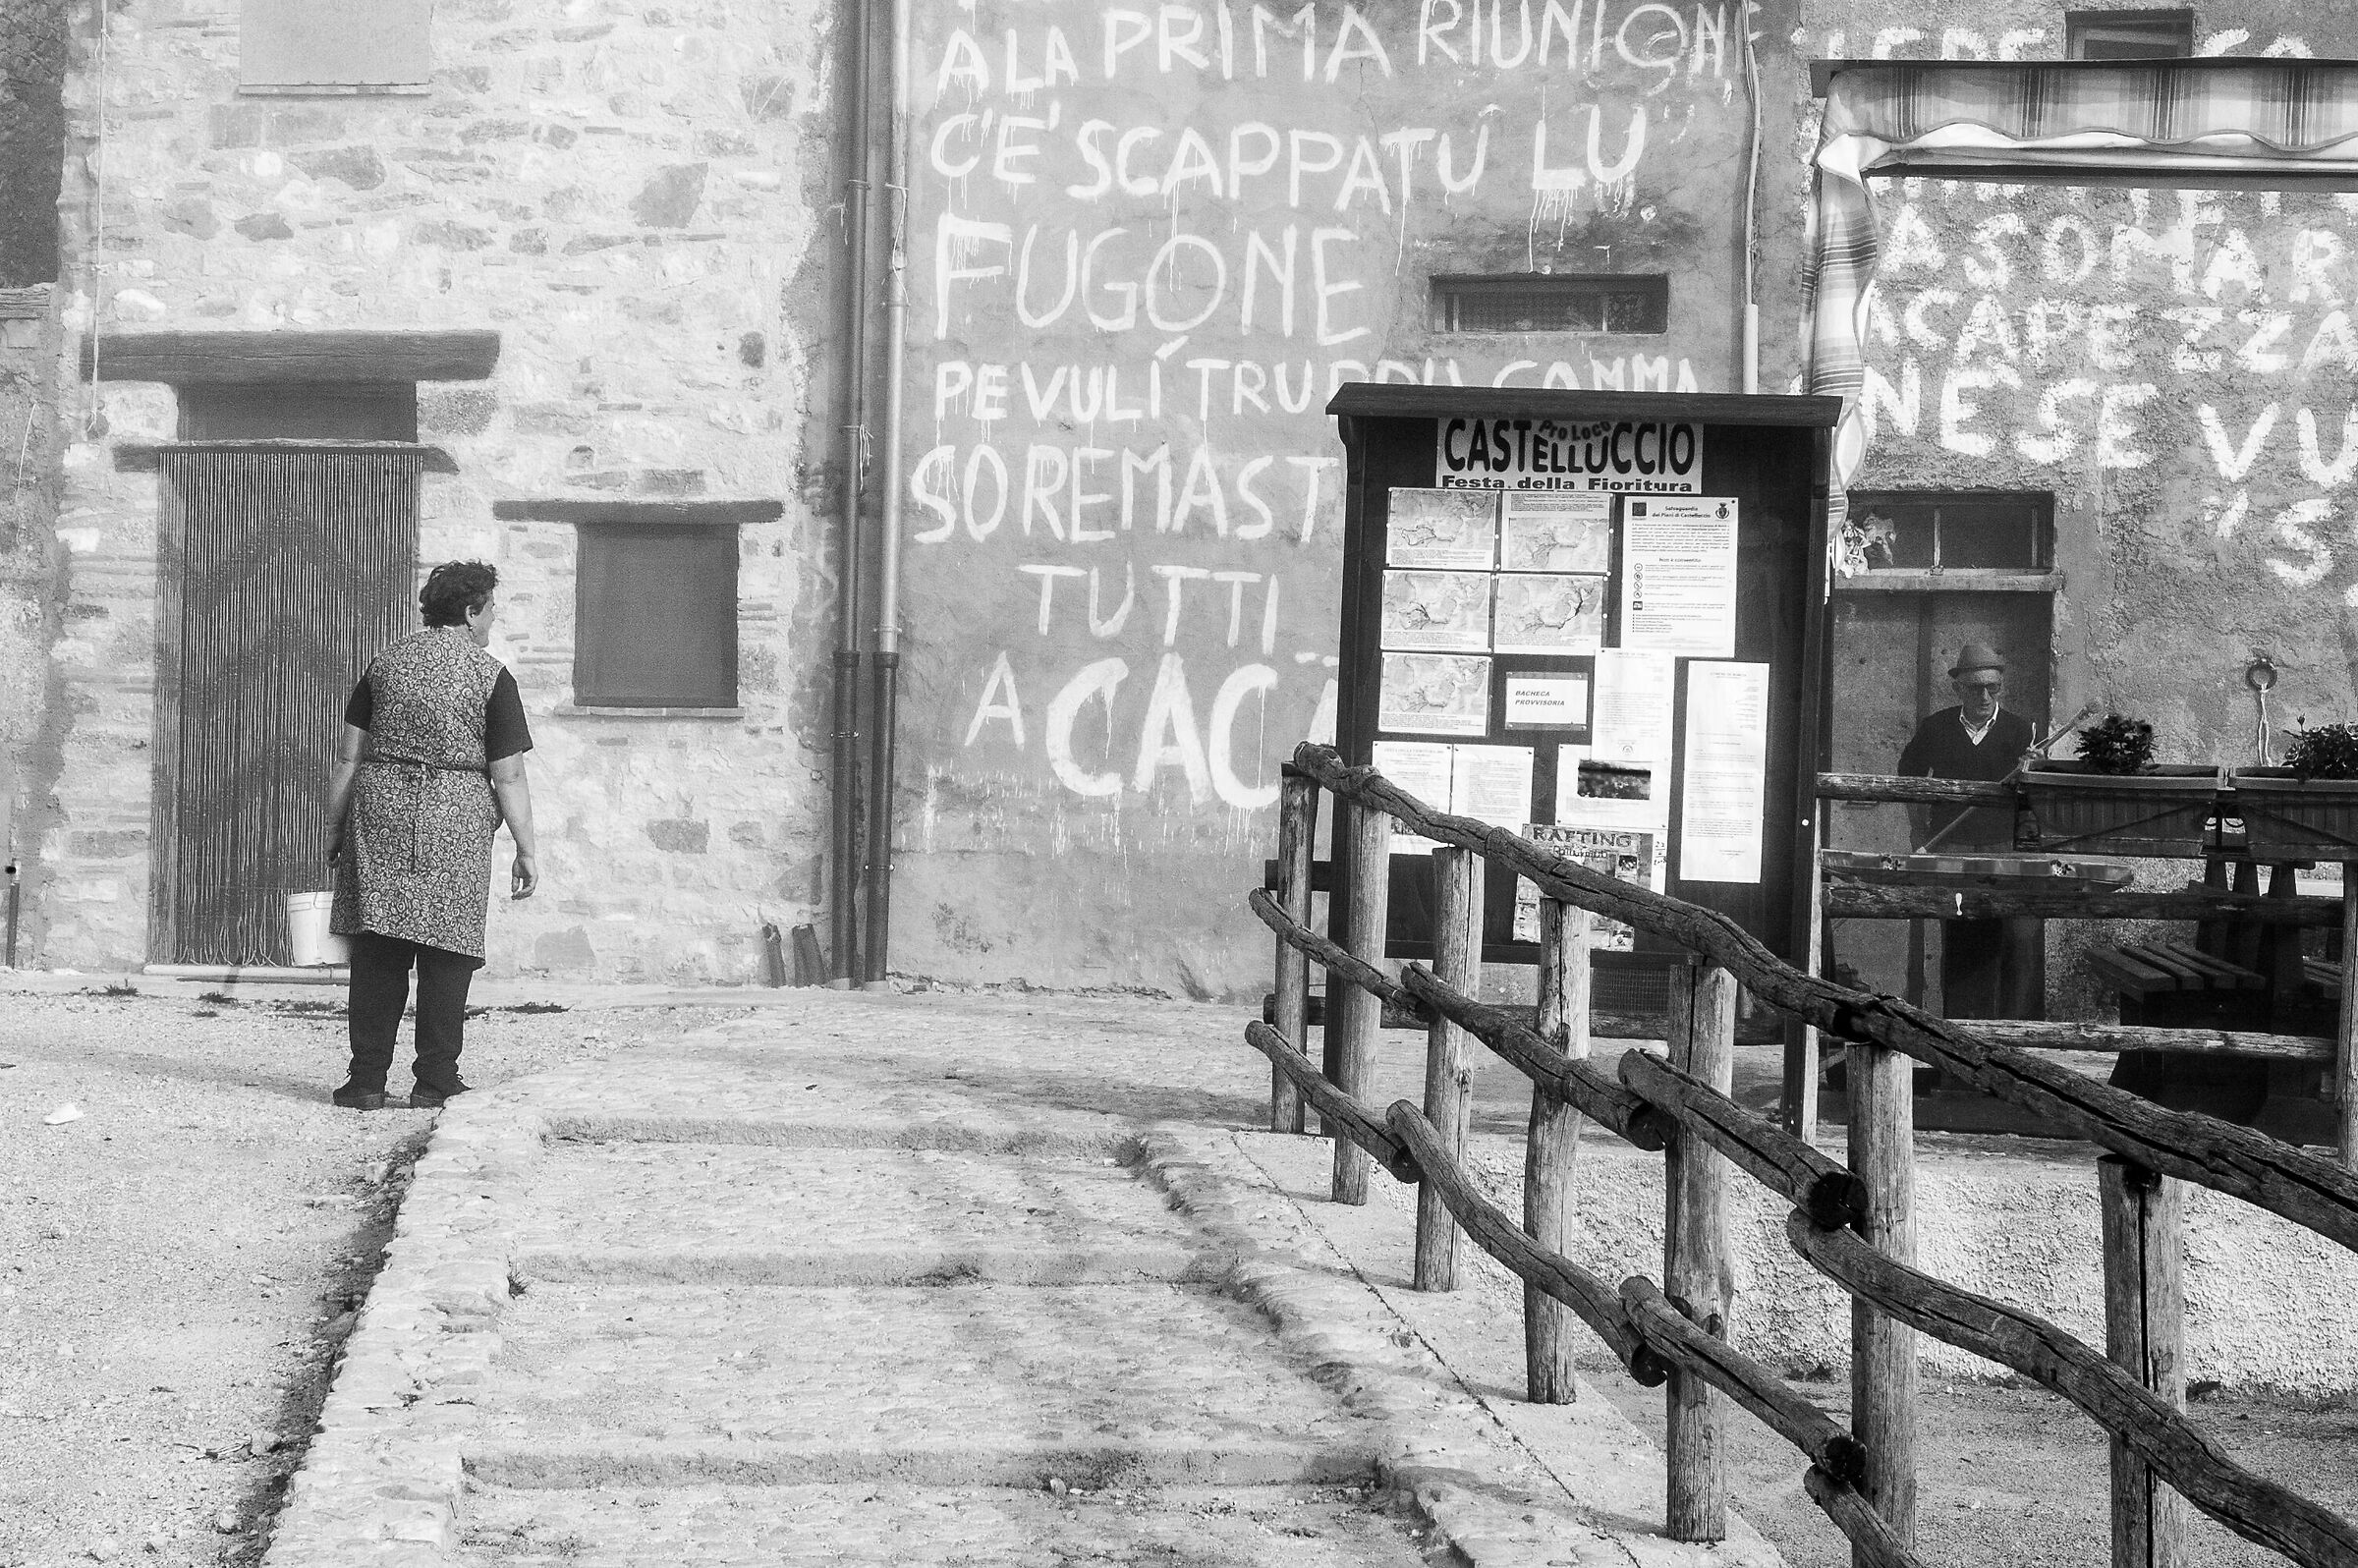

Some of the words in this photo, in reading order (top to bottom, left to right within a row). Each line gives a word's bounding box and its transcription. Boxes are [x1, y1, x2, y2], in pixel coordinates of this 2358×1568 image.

[1103, 3, 1391, 82] PRIMA
[1531, 103, 1647, 191] LU
[936, 212, 1372, 346] FUGONE
[1444, 418, 1696, 476] CASTELLUCCIO
[1539, 420, 1568, 440] Pro
[1572, 421, 1611, 440] Loco
[1441, 476, 1506, 489] Festa
[1517, 476, 1576, 490] della
[1588, 477, 1693, 492] Fioritura
[1016, 561, 1279, 655] TUTTI
[964, 650, 1025, 752] A
[1533, 827, 1632, 848] RAFTING
